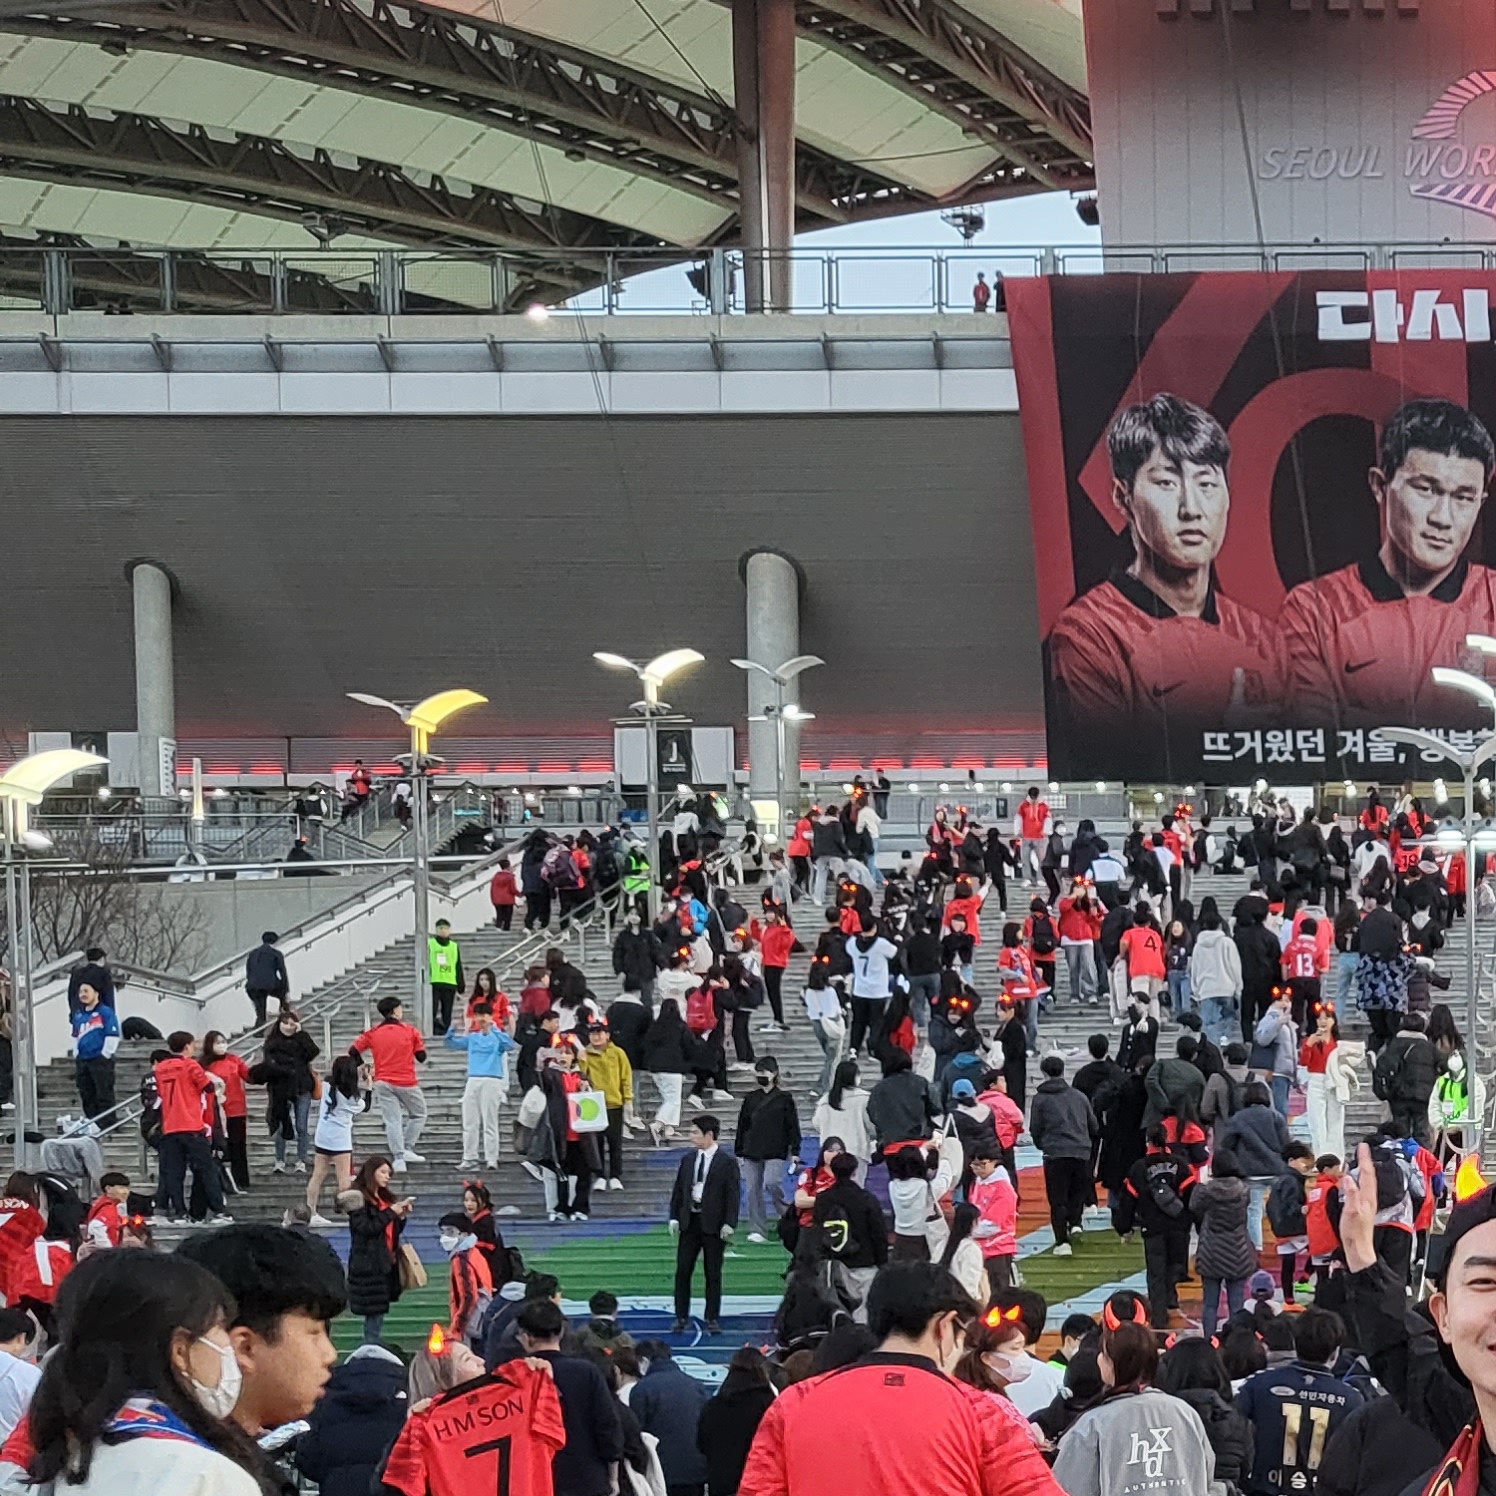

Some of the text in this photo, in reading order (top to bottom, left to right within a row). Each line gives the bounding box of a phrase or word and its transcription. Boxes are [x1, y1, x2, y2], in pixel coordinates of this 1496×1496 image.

[1258, 144, 1385, 181] SEOUL
[668, 741, 678, 763] J
[1201, 729, 1326, 765] 뜨거웠던
[894, 911, 907, 931] 7
[1143, 935, 1157, 952] 4
[858, 955, 870, 977] 7
[1296, 952, 1315, 977] 13
[163, 1078, 176, 1107] 7
[1281, 1402, 1331, 1470] 11
[1123, 1478, 1187, 1493] AUTHENTIC
[1268, 1469, 1318, 1489] 이승
